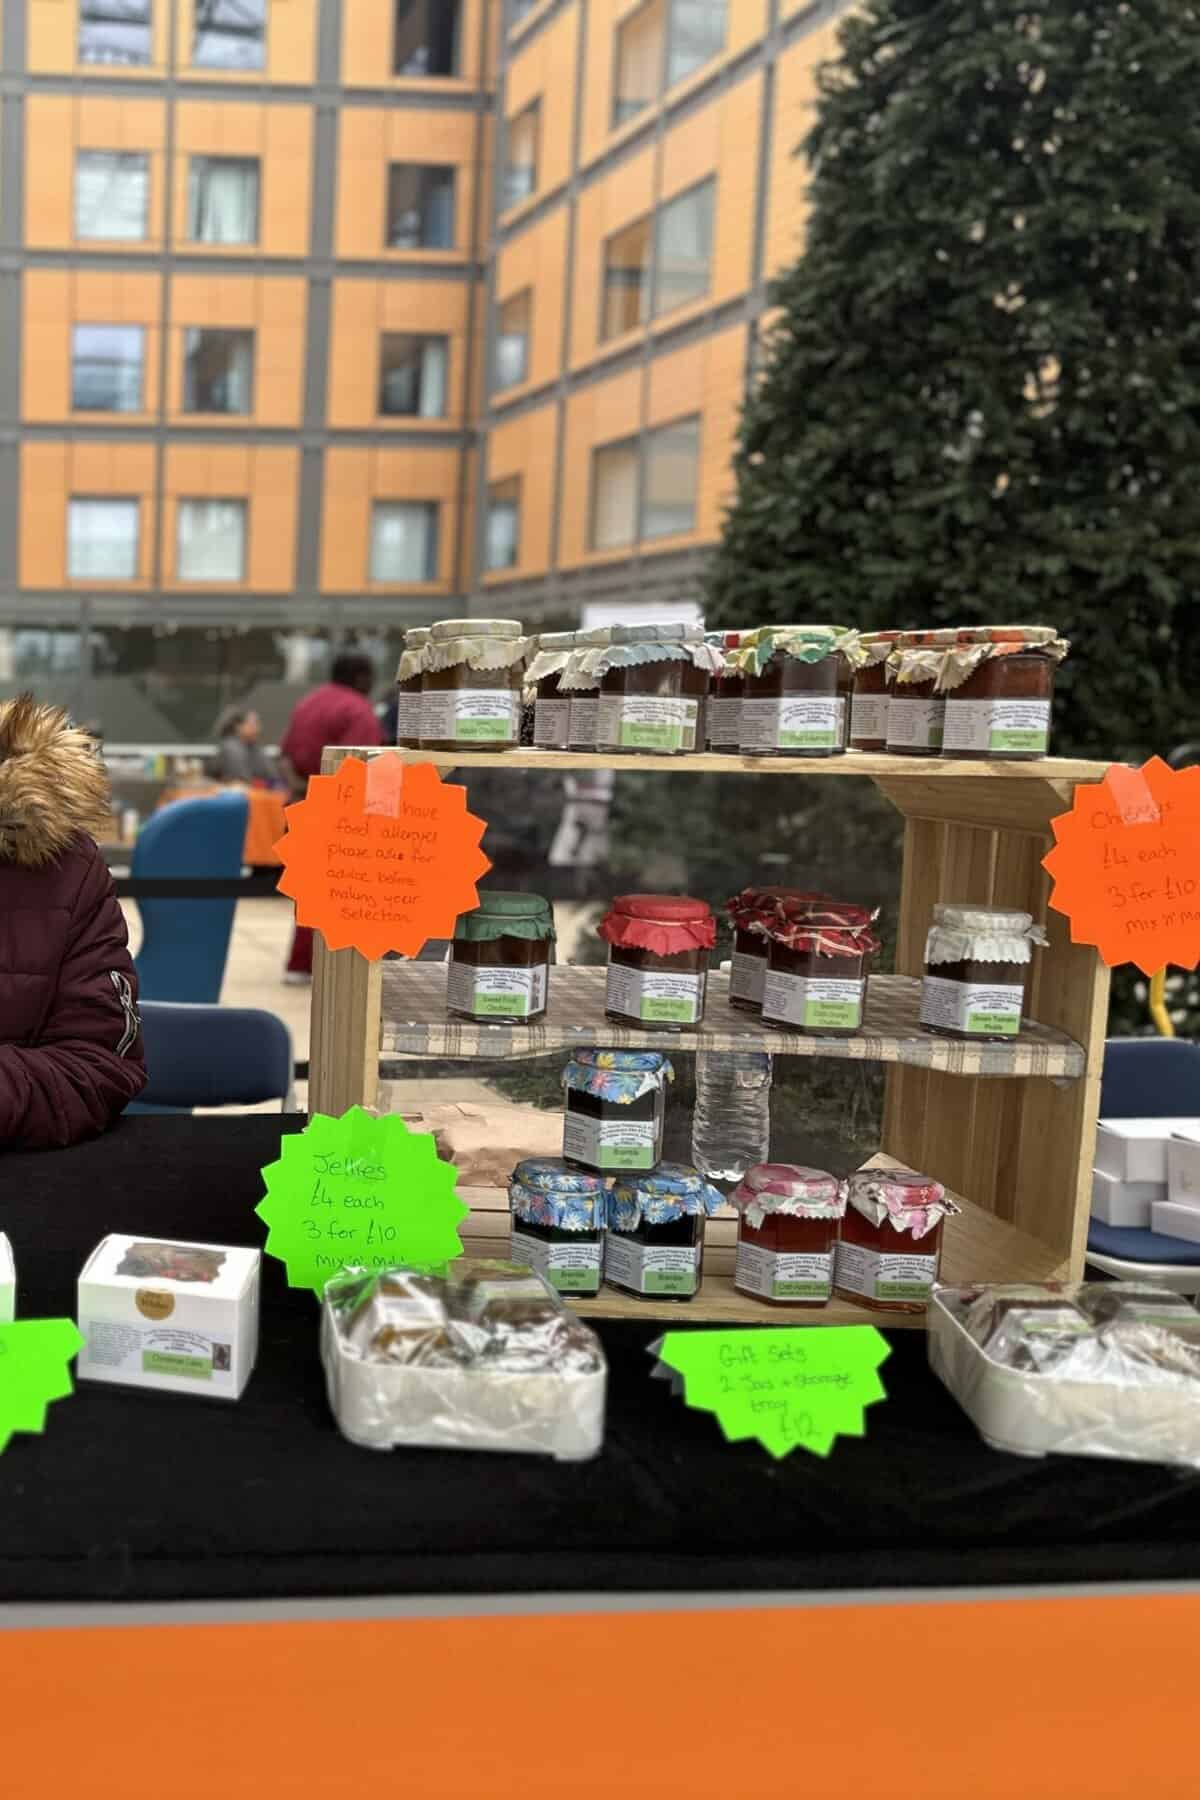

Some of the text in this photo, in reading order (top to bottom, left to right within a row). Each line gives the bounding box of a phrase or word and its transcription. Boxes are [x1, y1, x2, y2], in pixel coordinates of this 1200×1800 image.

[336, 783, 353, 804] If
[402, 800, 439, 820] have
[335, 817, 369, 837] food
[1136, 840, 1177, 864] each
[1107, 875, 1197, 911] 3 for £10
[312, 1152, 387, 1181] Jellies
[310, 1178, 386, 1210] £4 each
[301, 1218, 398, 1245] 3 for £10
[720, 1343, 759, 1367] Gift
[720, 1375, 735, 1392] 2
[779, 1410, 822, 1442] £12
